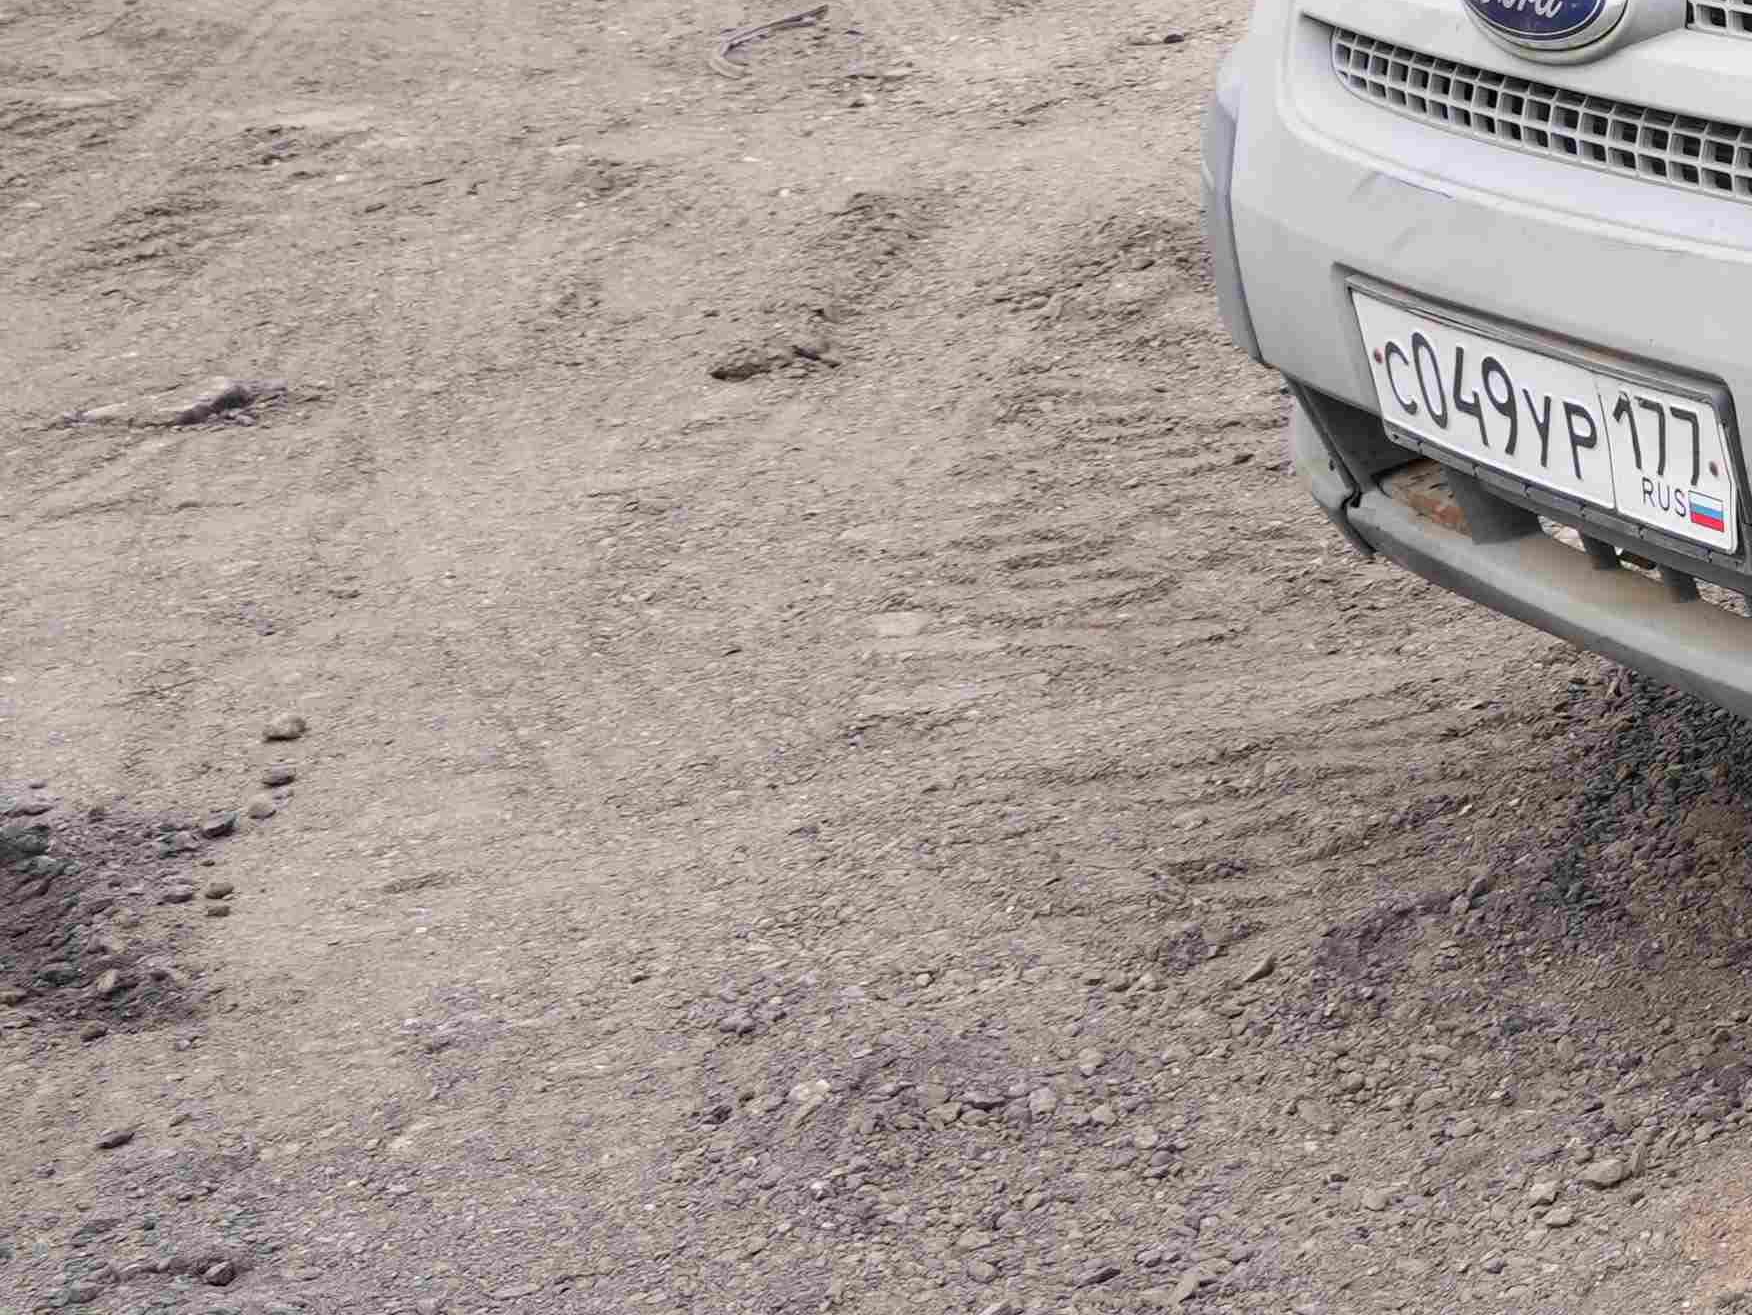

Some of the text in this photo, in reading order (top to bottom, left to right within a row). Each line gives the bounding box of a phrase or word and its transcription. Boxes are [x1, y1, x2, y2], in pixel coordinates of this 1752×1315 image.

[1385, 332, 1700, 487] С049УР 177
[1642, 477, 1687, 517] RUS
